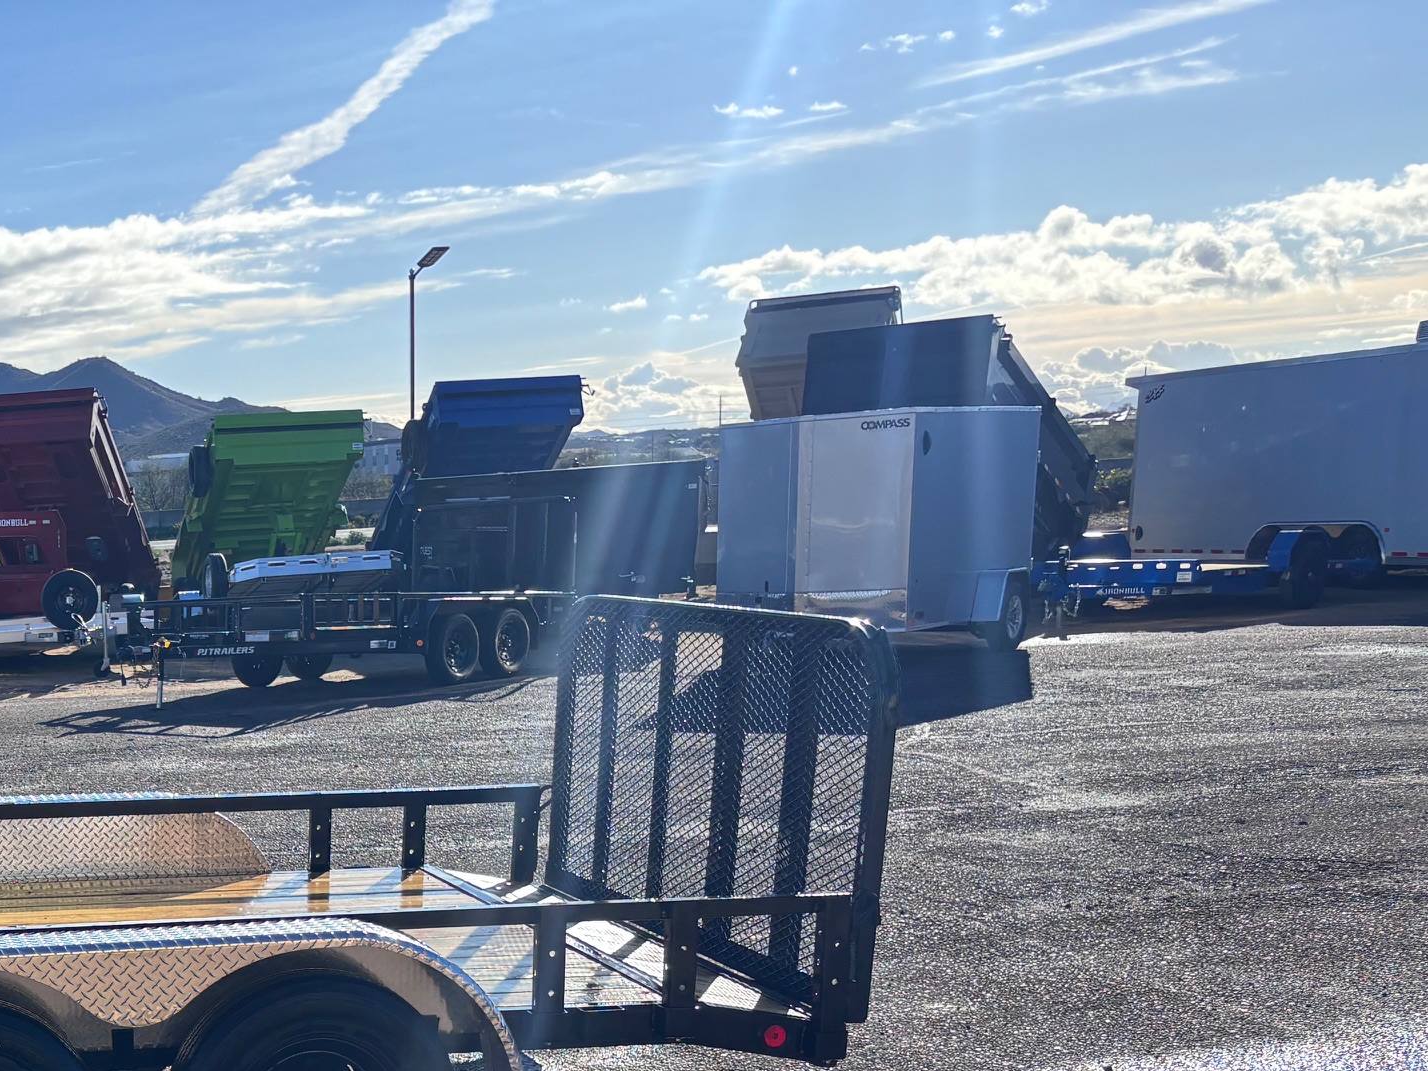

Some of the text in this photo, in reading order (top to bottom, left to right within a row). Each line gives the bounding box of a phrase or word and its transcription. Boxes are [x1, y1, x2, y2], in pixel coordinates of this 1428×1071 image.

[860, 418, 911, 430] COMPASS
[1104, 587, 1146, 596] IRONBULL
[196, 646, 255, 656] PJ TRAILERS
